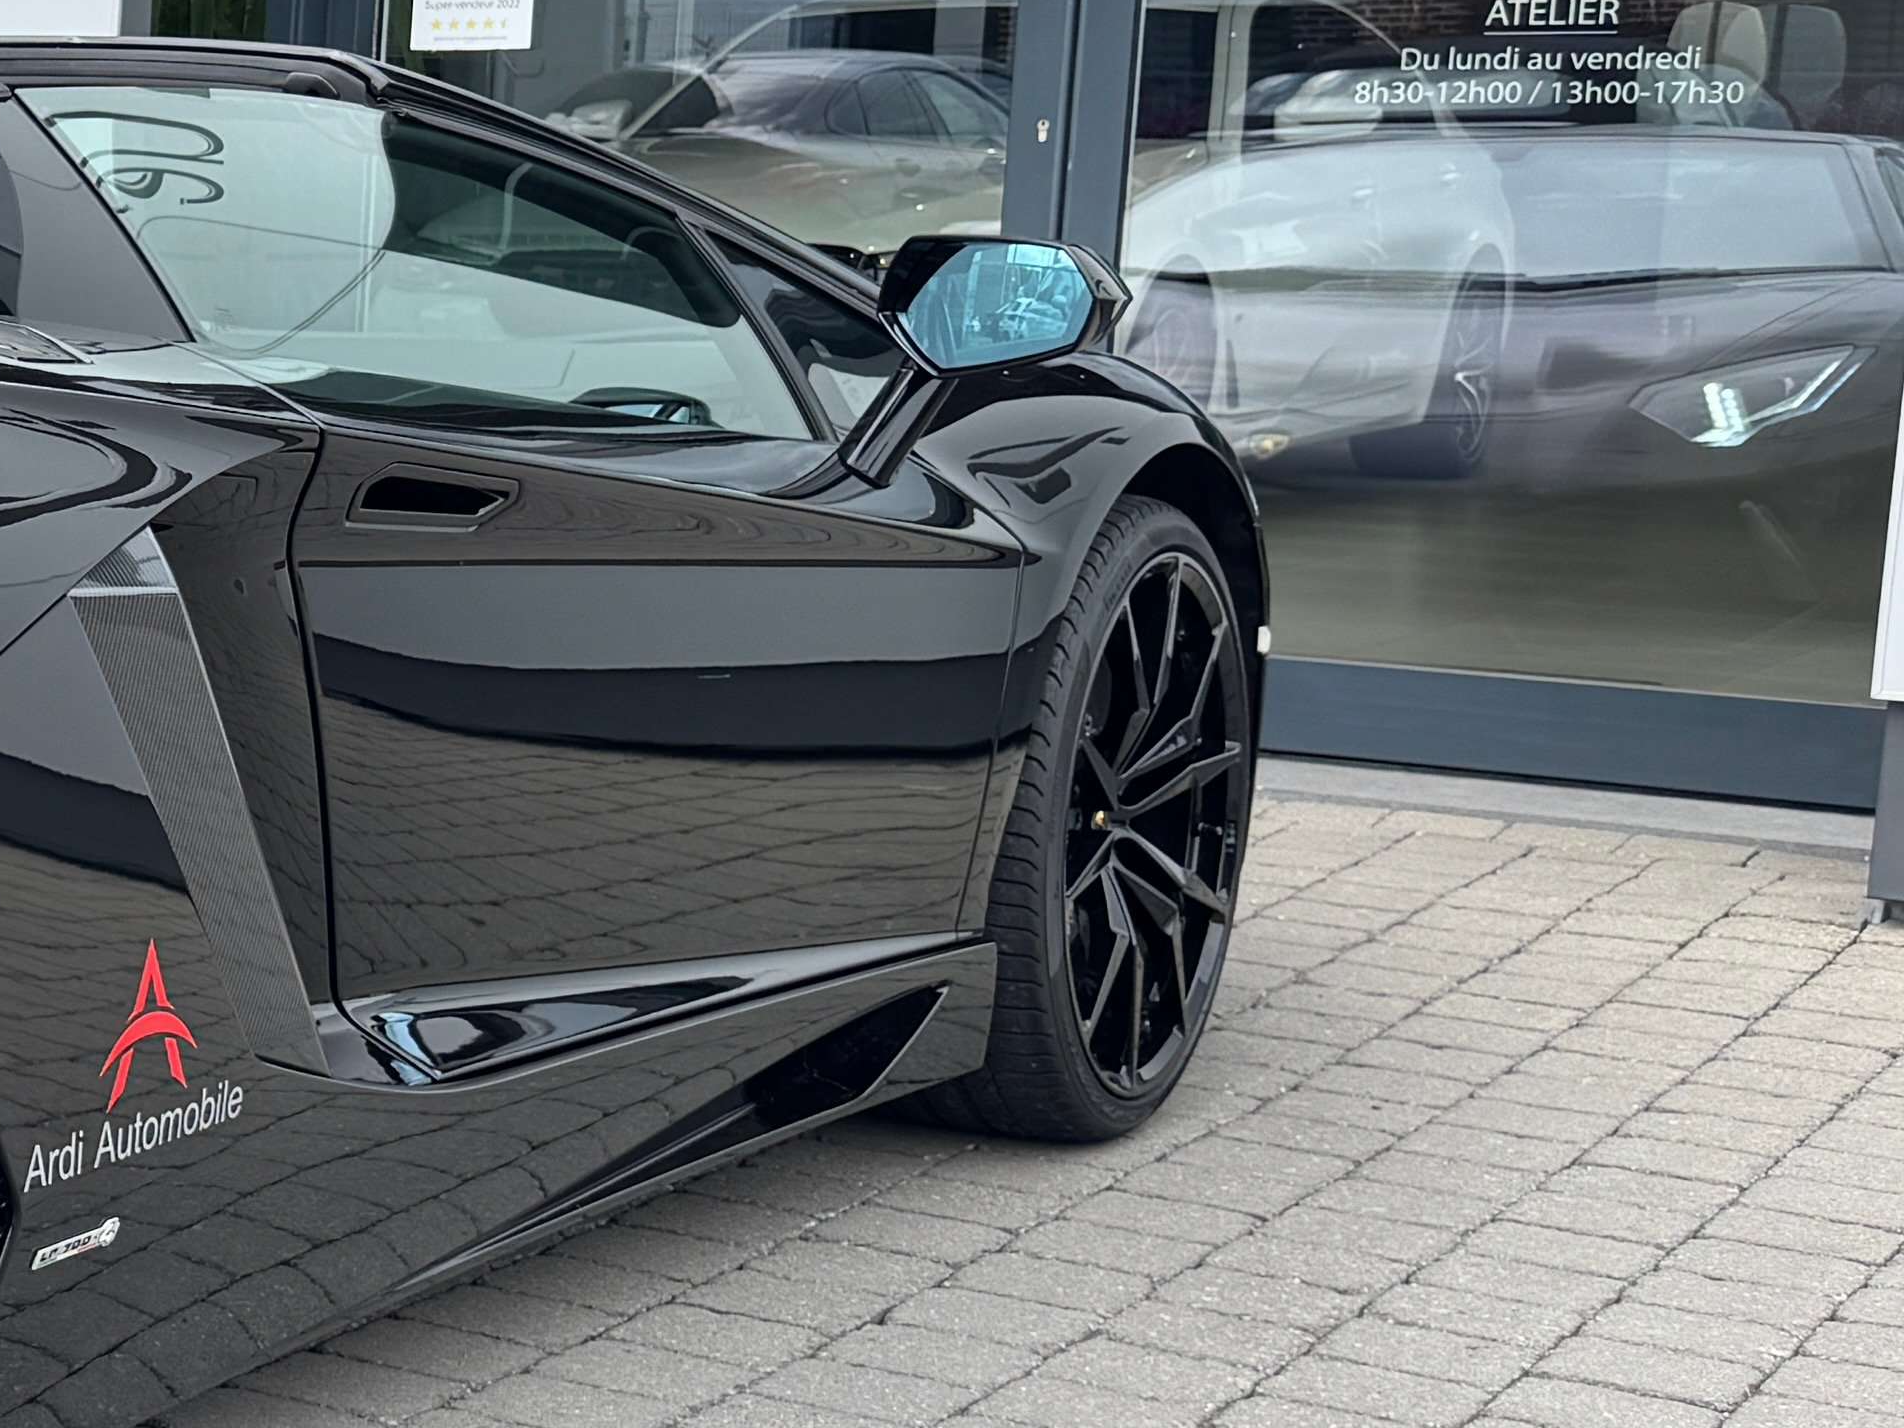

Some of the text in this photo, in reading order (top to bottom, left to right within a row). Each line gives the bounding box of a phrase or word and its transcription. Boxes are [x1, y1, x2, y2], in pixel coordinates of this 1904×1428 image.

[1400, 45, 1702, 71] Du lundi au vendredi
[1354, 79, 1523, 104] 8h30-12h00
[1551, 78, 1745, 104] 13h00-17h30
[24, 1079, 243, 1194] Ardi Automobile
